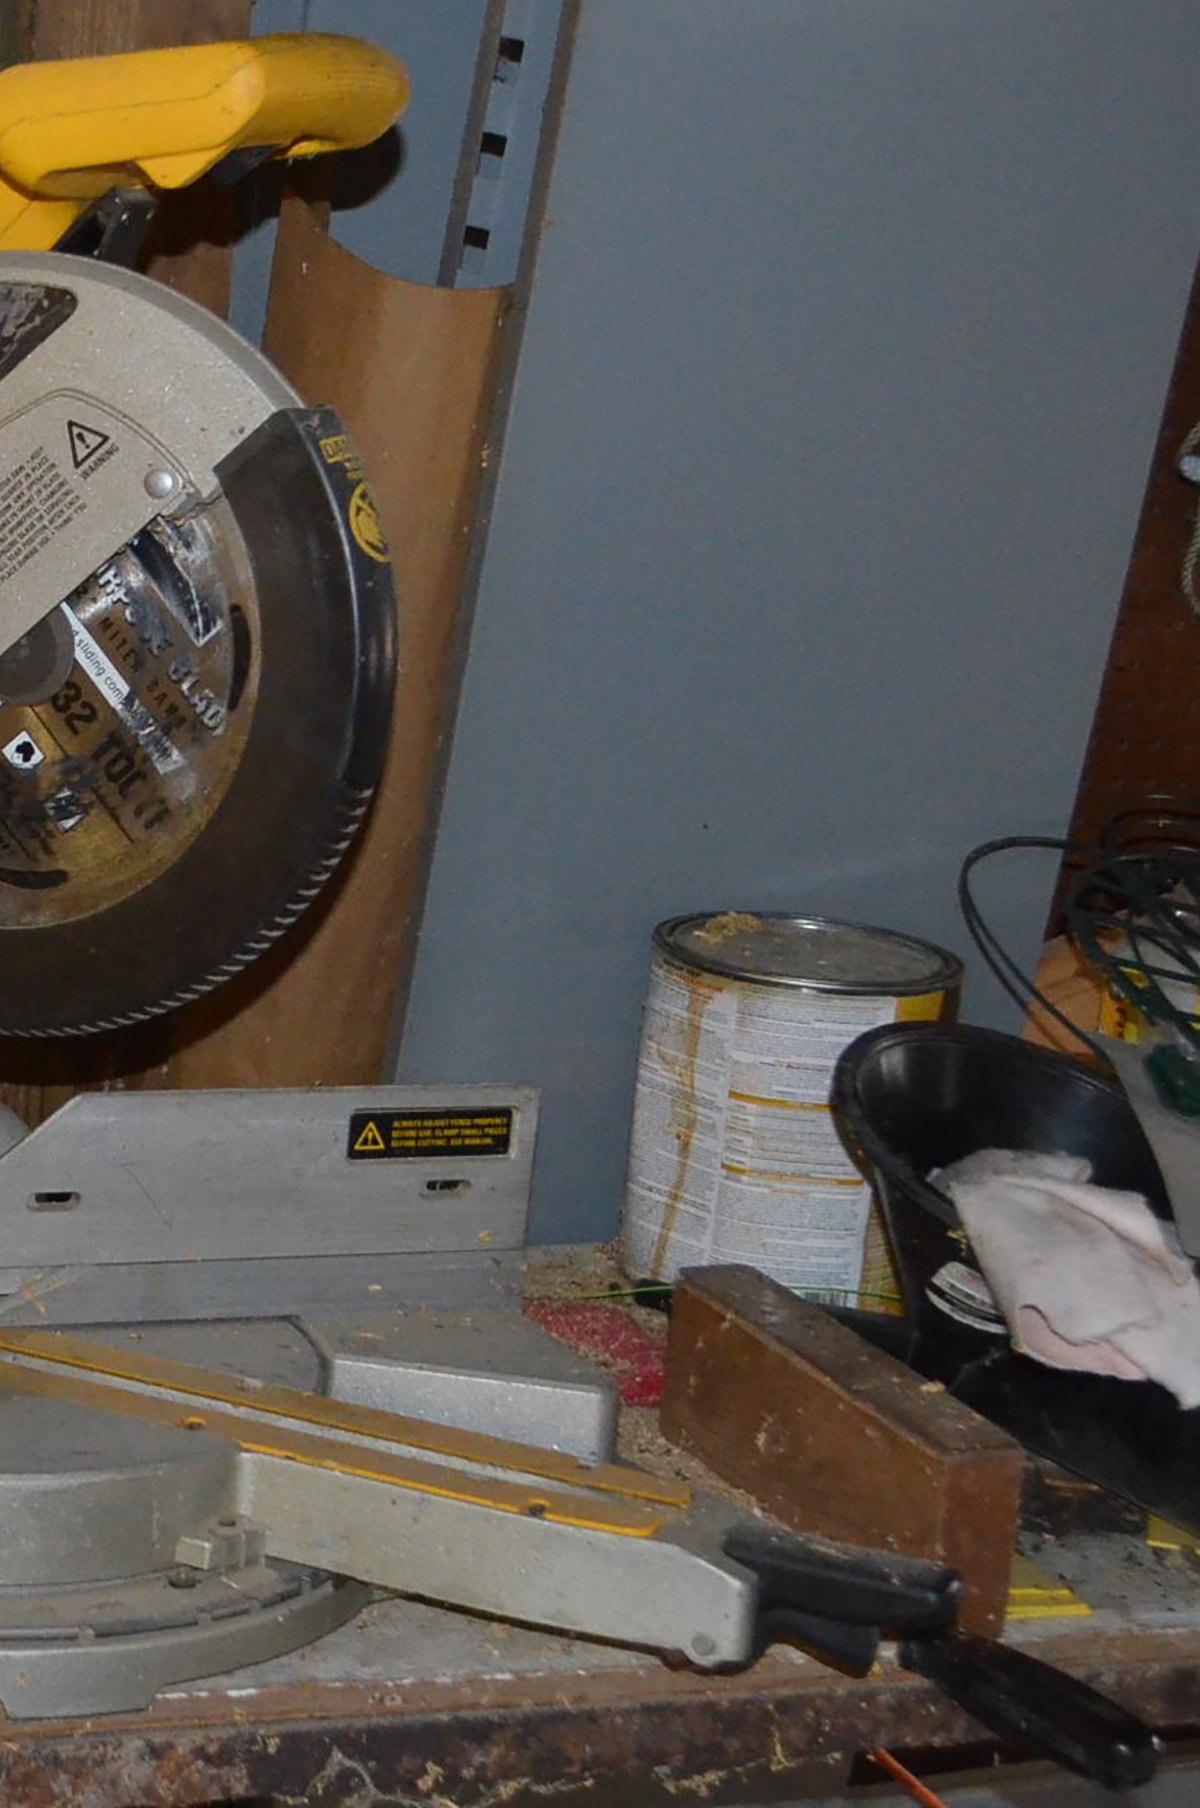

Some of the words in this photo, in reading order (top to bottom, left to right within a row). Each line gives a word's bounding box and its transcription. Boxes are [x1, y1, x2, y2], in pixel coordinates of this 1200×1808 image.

[77, 442, 120, 481] WARNING
[72, 635, 109, 679] sliding
[46, 677, 103, 738] 32
